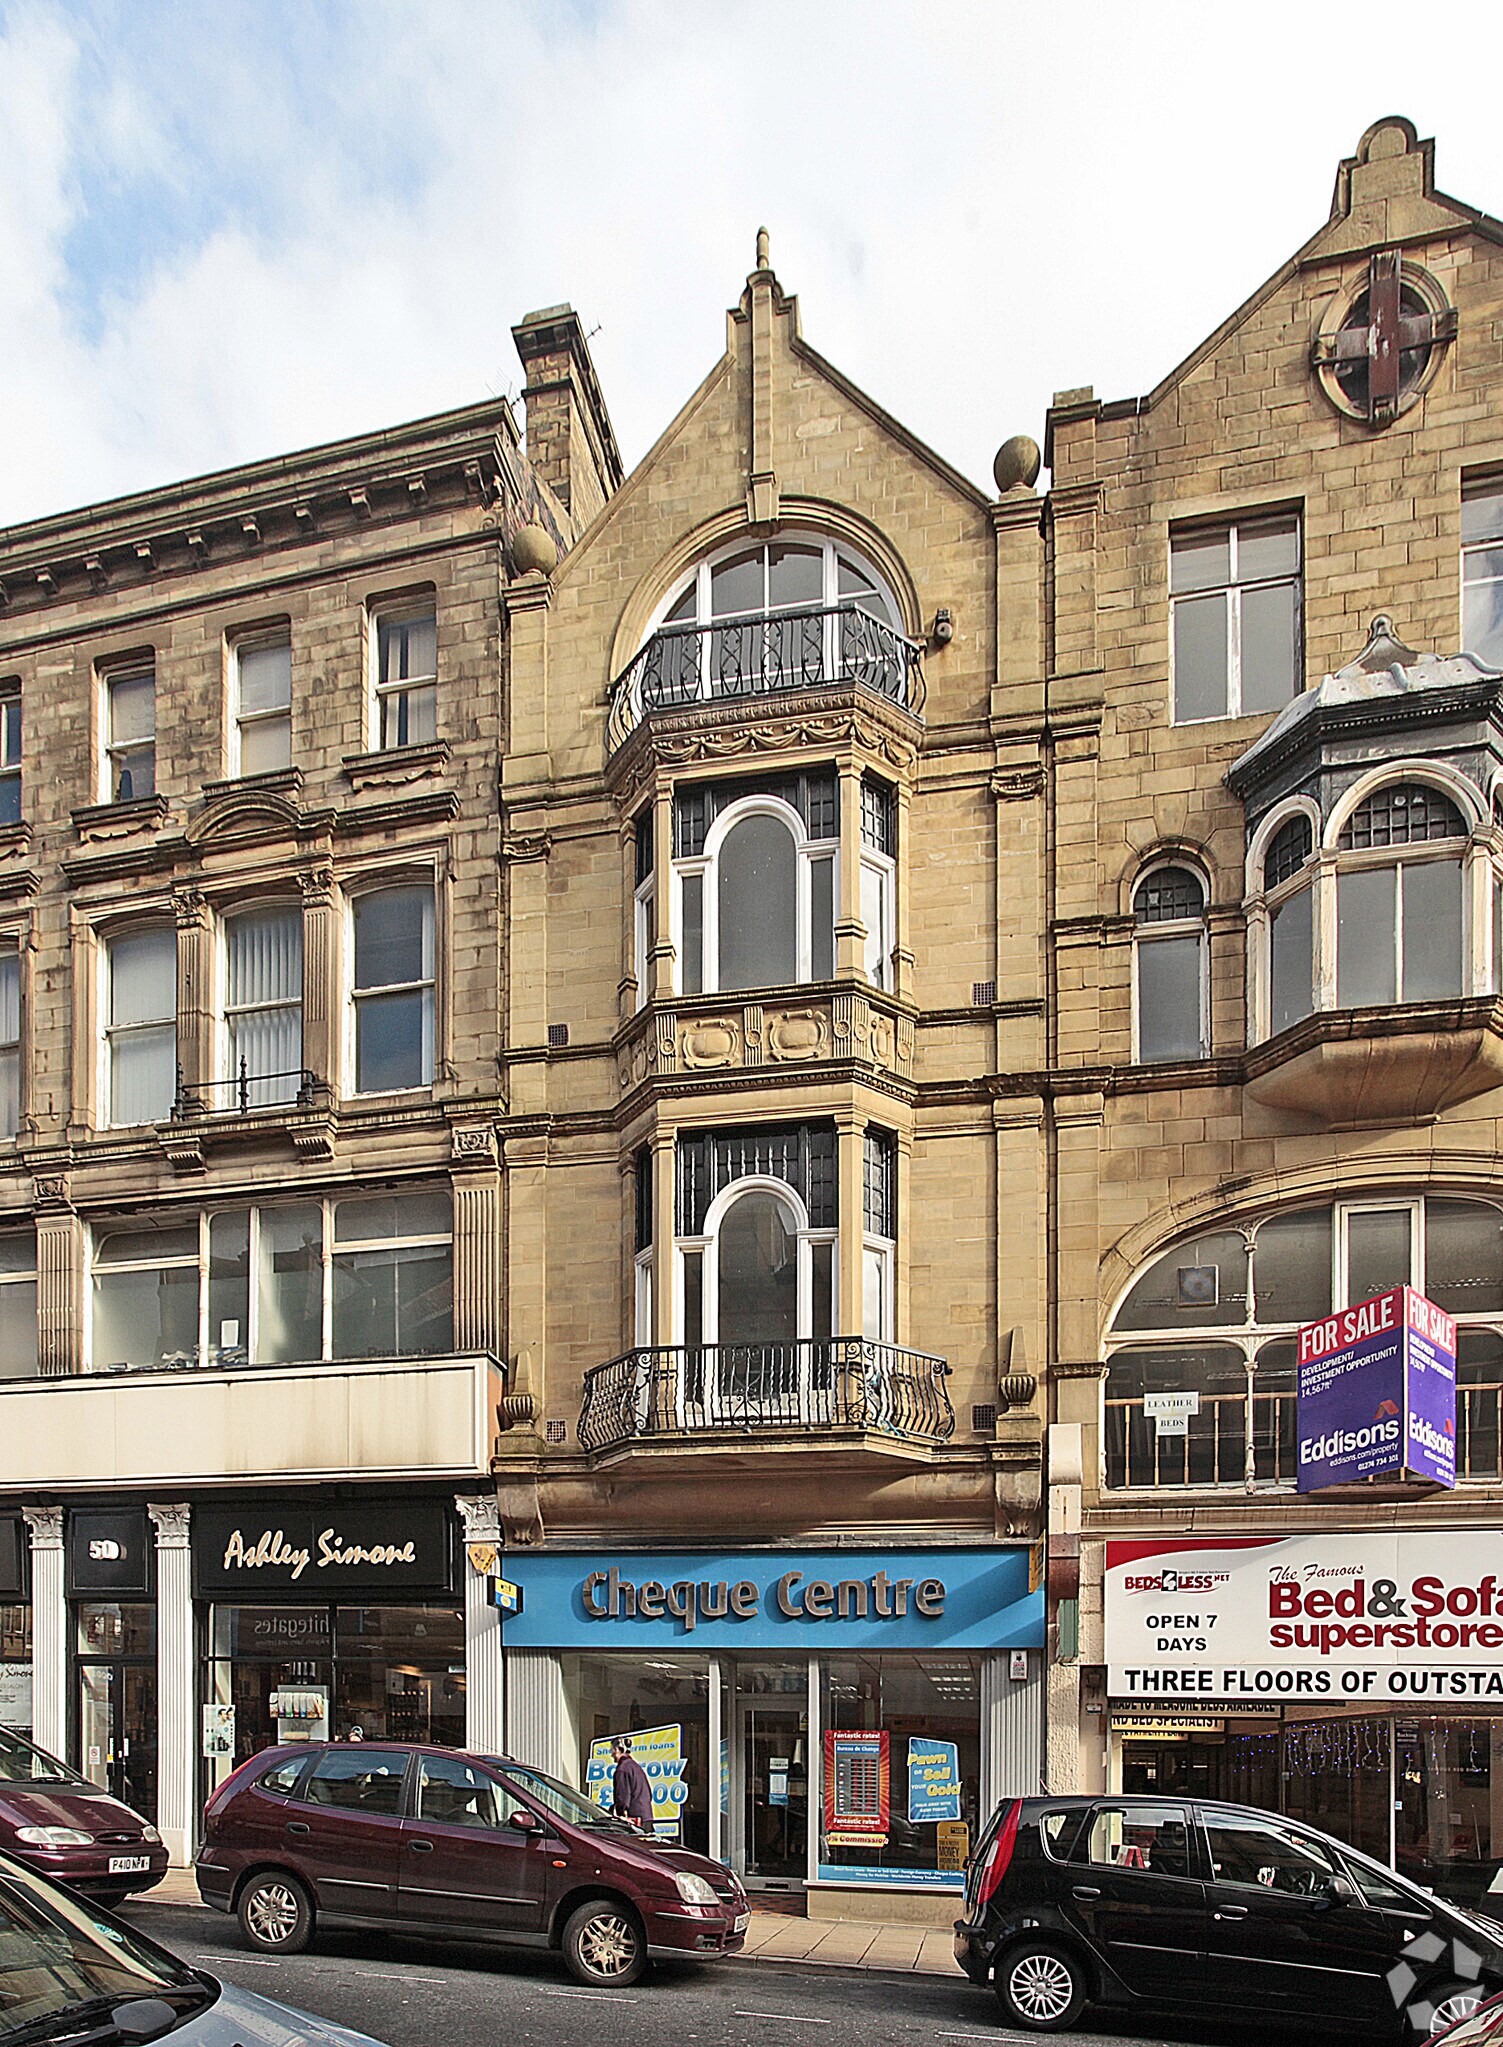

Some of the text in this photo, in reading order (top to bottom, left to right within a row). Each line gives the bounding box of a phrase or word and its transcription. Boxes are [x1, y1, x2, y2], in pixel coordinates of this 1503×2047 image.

[1301, 1295, 1394, 1361] FOR SALE
[1409, 1293, 1429, 1336] FOR
[1430, 1308, 1453, 1352] SALE
[1301, 1364, 1346, 1388] INVESTMENT
[1346, 1345, 1398, 1372] OPPORTUNITY
[1148, 1399, 1193, 1408] LEATHER
[1160, 1419, 1184, 1427] BEDS
[1300, 1419, 1399, 1465] Eddisons
[1409, 1411, 1455, 1460] Eddisons
[89, 1539, 120, 1560] 50
[223, 1527, 416, 1580] Ashley Simone
[1269, 1563, 1366, 1583] The Famous
[583, 1566, 947, 1630] Cheque Centre
[1269, 1578, 1365, 1618] Bed
[1367, 1579, 1408, 1618] &
[1145, 1615, 1218, 1629] OPEN 7
[1157, 1637, 1207, 1651] DAYS
[1125, 1670, 1503, 1695] THREE FLOORS OF OUTSTA
[1156, 1717, 1218, 1728] SPECIALIST
[650, 1742, 675, 1751] loans
[908, 1754, 948, 1766] Pawn
[588, 1760, 684, 1781] Boow
[923, 1766, 952, 1781] Sell
[926, 1782, 962, 1797] Gold
[839, 1835, 888, 1844] Commission
